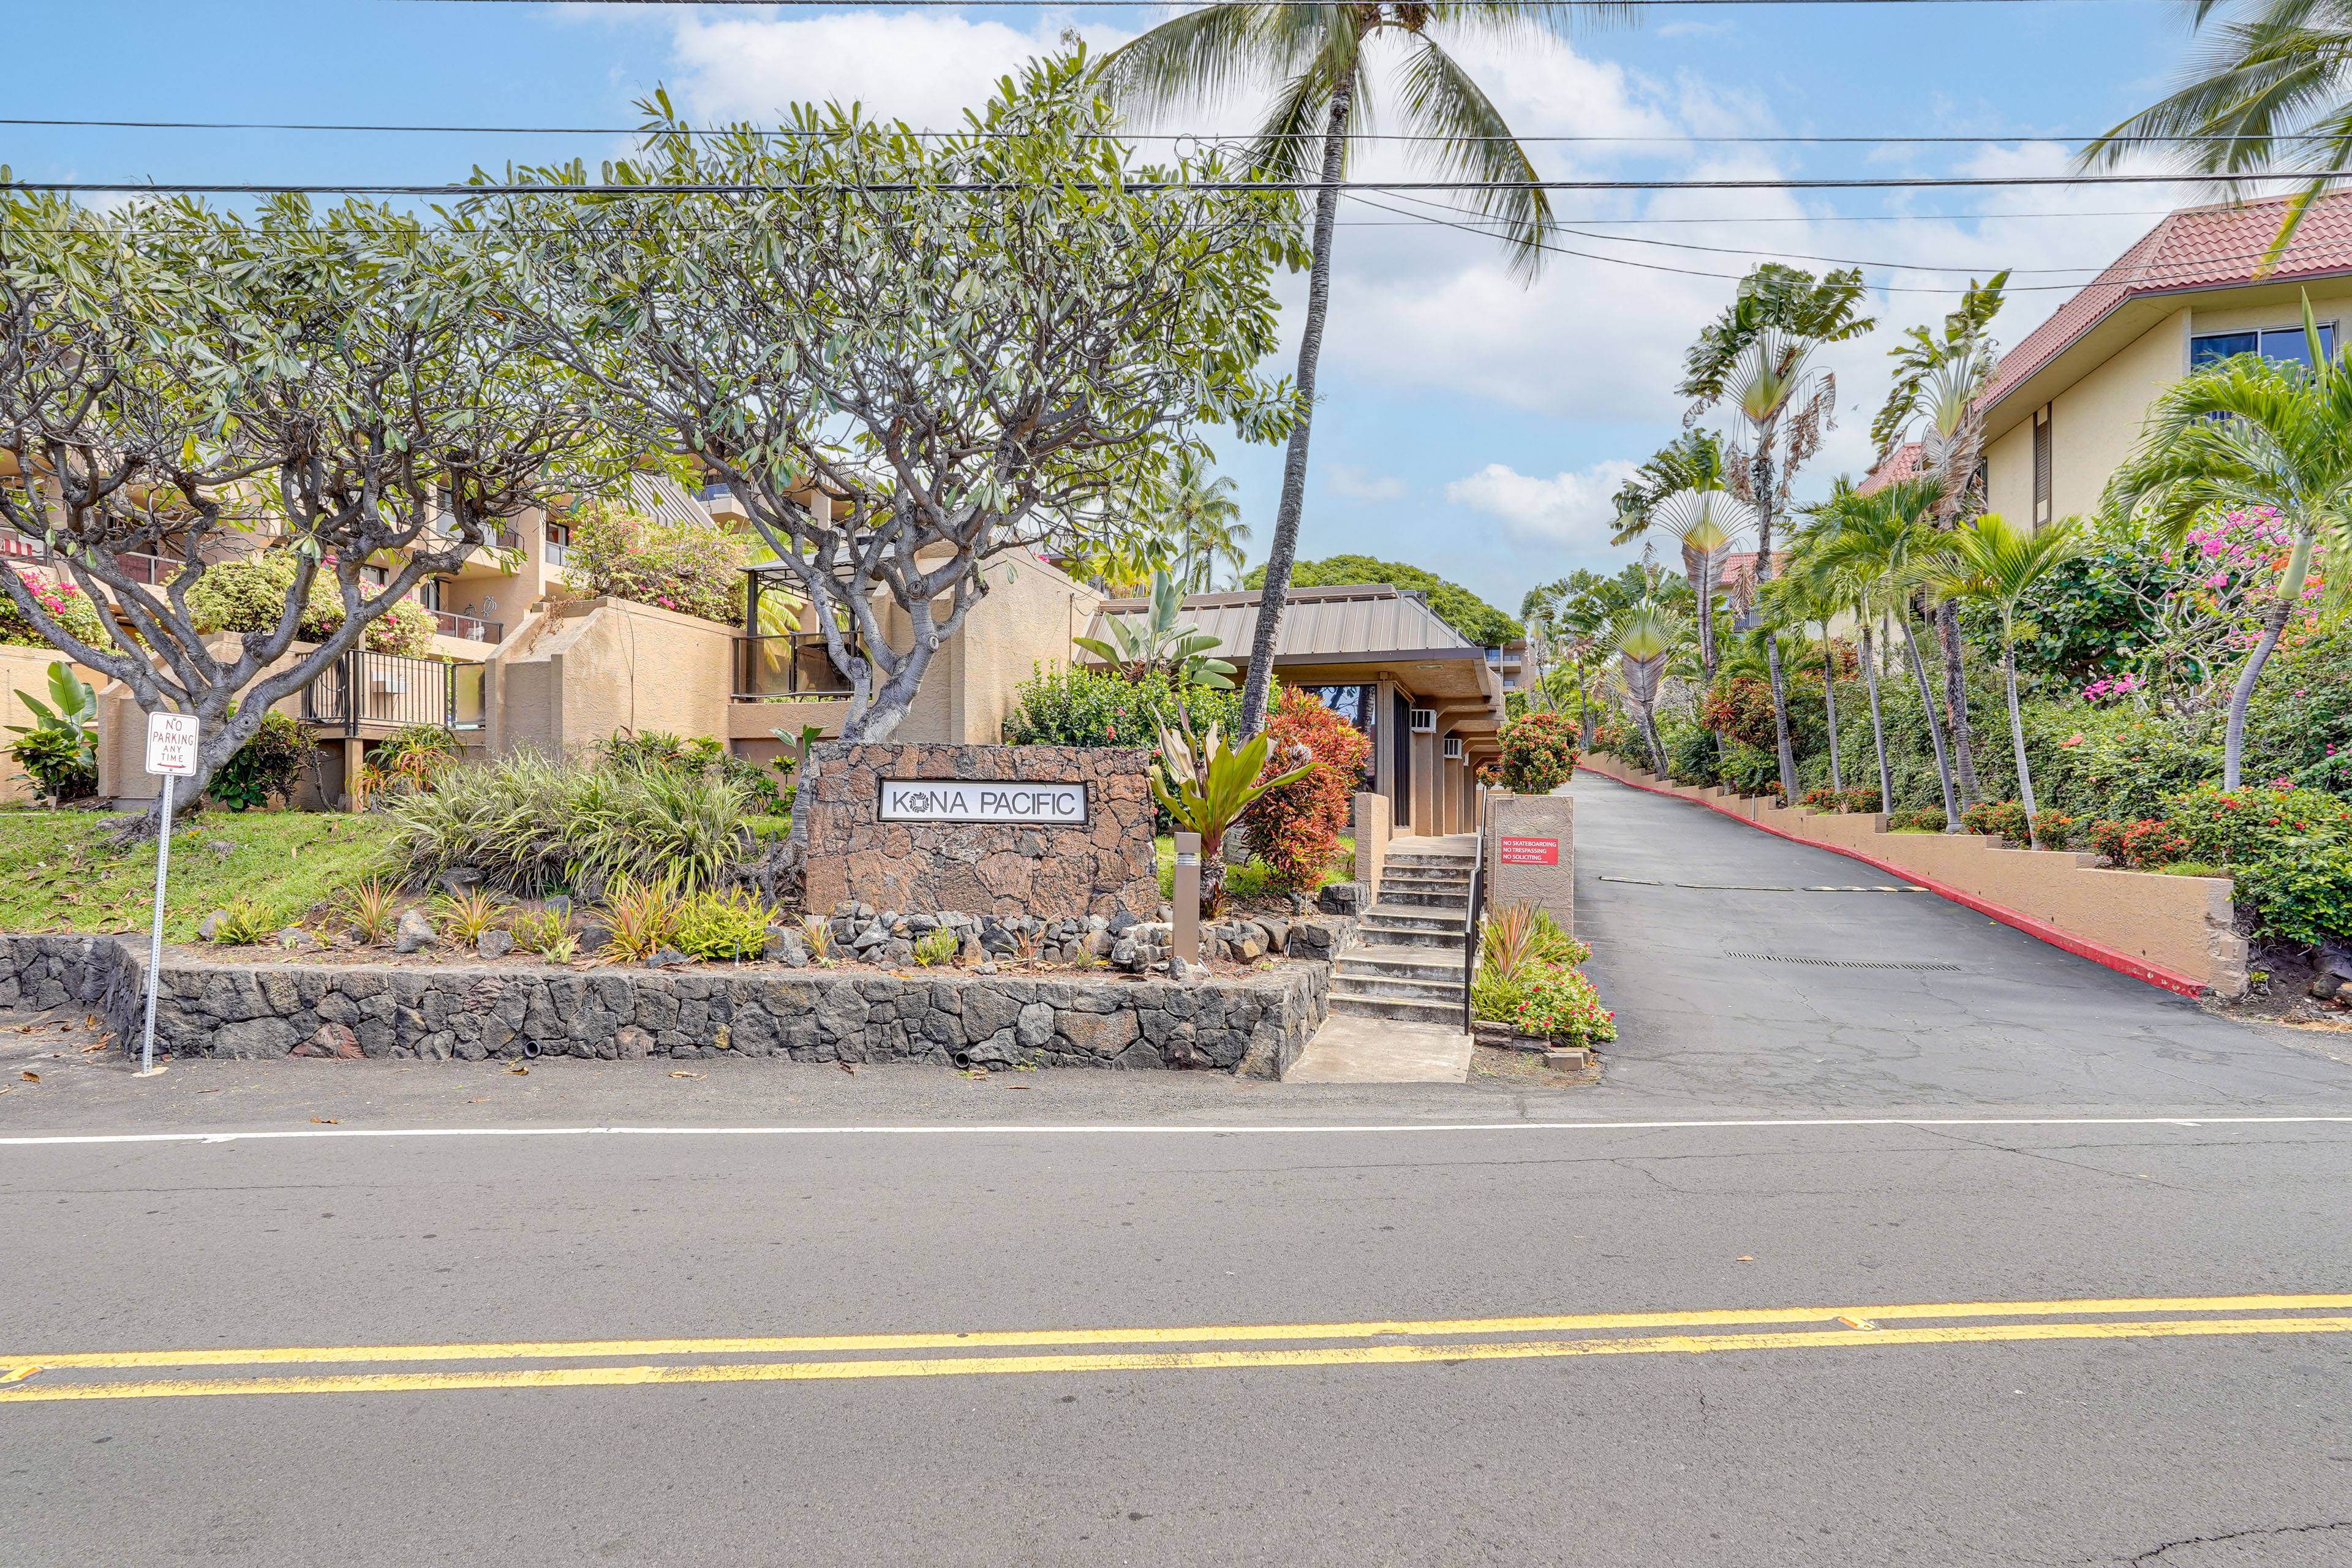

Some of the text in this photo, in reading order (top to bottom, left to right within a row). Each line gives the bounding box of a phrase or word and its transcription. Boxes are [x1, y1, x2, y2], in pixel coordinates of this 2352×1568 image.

[166, 720, 182, 731] NO
[153, 732, 194, 745] PARKING
[162, 753, 183, 762] TIME
[893, 791, 1075, 815] KONA PACIFIC
